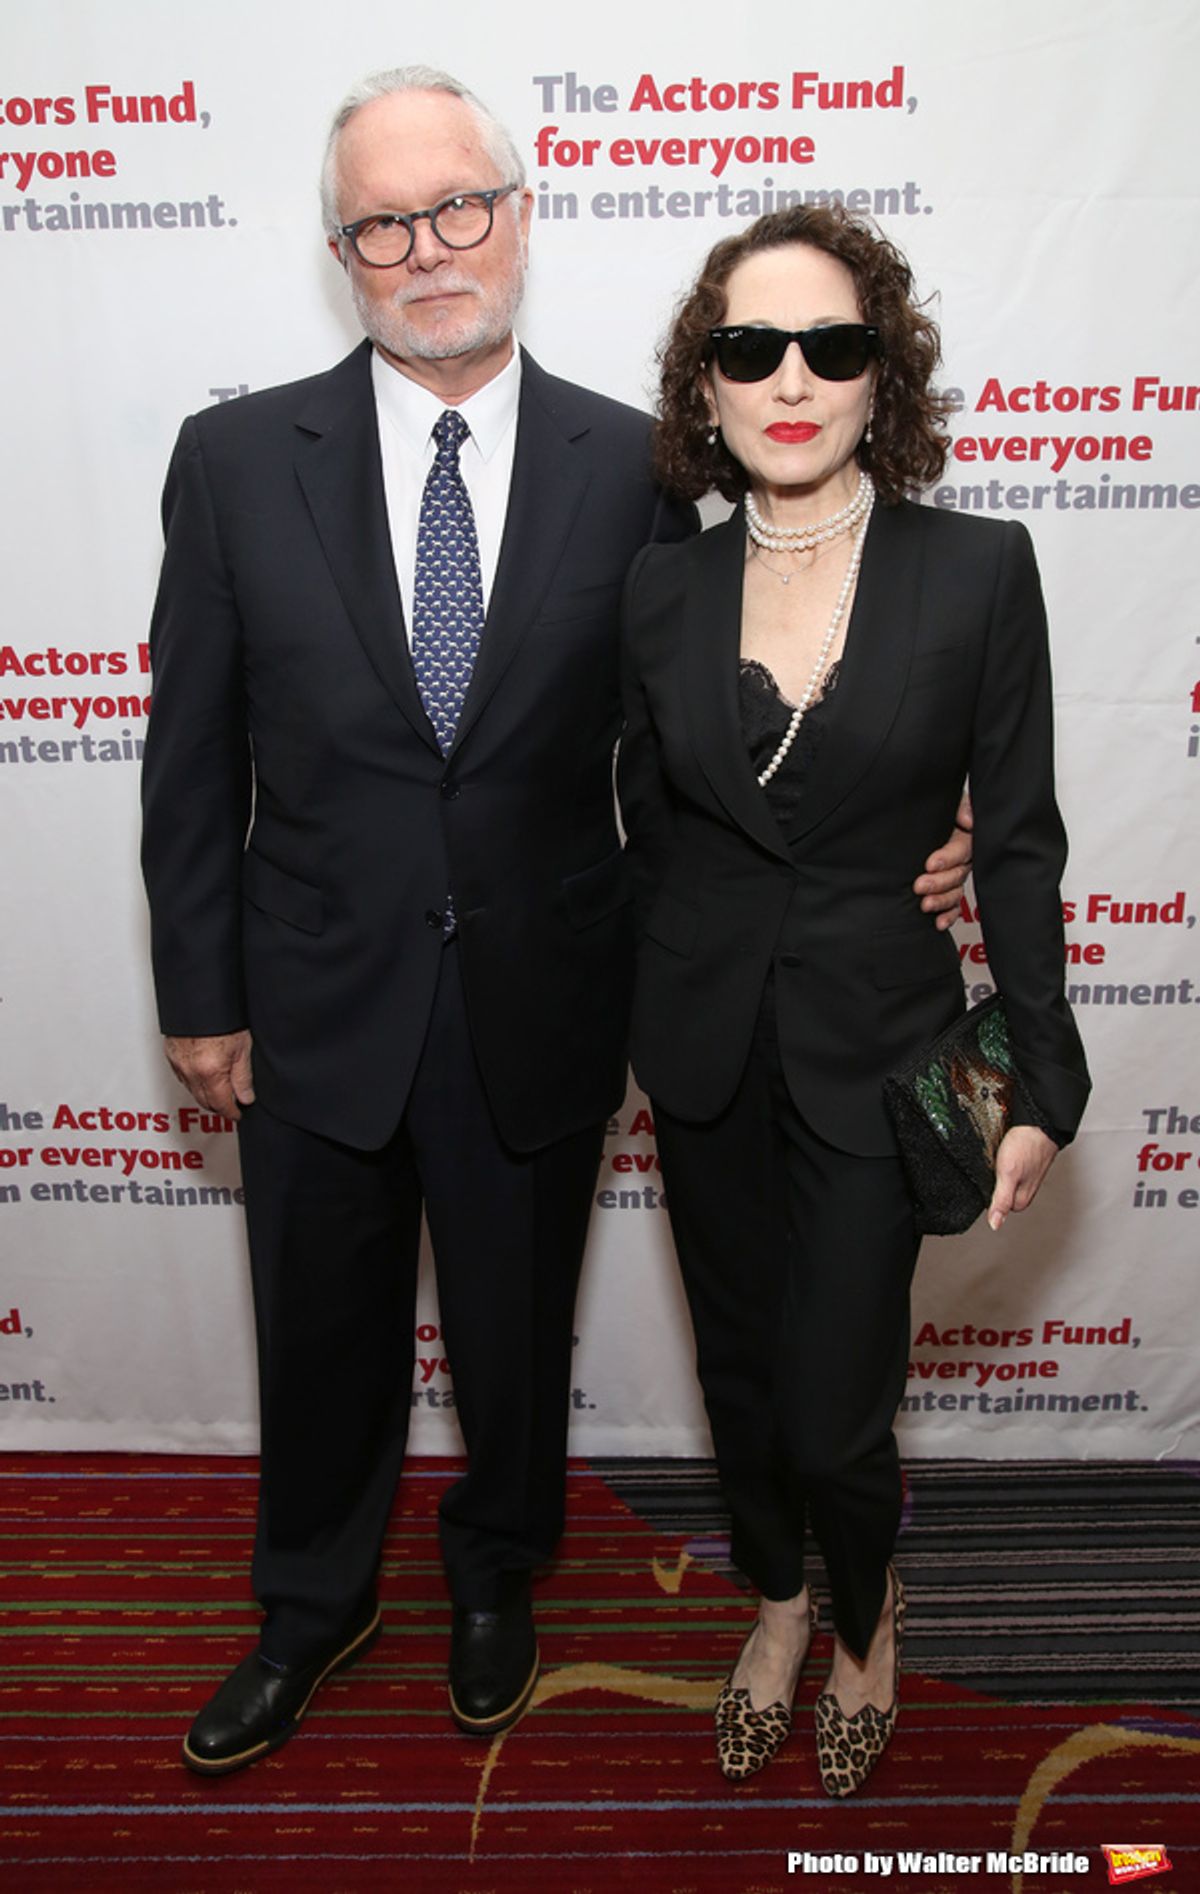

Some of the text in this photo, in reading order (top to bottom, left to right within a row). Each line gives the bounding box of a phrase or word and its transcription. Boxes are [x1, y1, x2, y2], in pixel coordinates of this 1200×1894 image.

[85, 81, 211, 129] Fund,
[533, 66, 918, 114] The Actors Fund,
[534, 126, 816, 178] for everyone
[2, 191, 238, 232] rtainment.
[537, 177, 934, 220] in entertainment.
[975, 378, 1121, 412] Actors
[1132, 377, 1200, 411] Fun
[953, 435, 1153, 473] everyone
[933, 474, 1200, 510] entertainme
[0, 646, 128, 677] Actors
[0, 695, 152, 730] veryon
[1086, 891, 1195, 929] Fund,
[0, 1102, 43, 1131] he
[52, 1104, 170, 1132] Actors
[0, 1147, 204, 1177] or everyone
[1136, 1143, 1192, 1172] for
[30, 1180, 246, 1206] entertainme
[1133, 1181, 1167, 1208] in
[914, 1318, 1141, 1348] Actors Fund,
[901, 1387, 1149, 1414] ntertainment.
